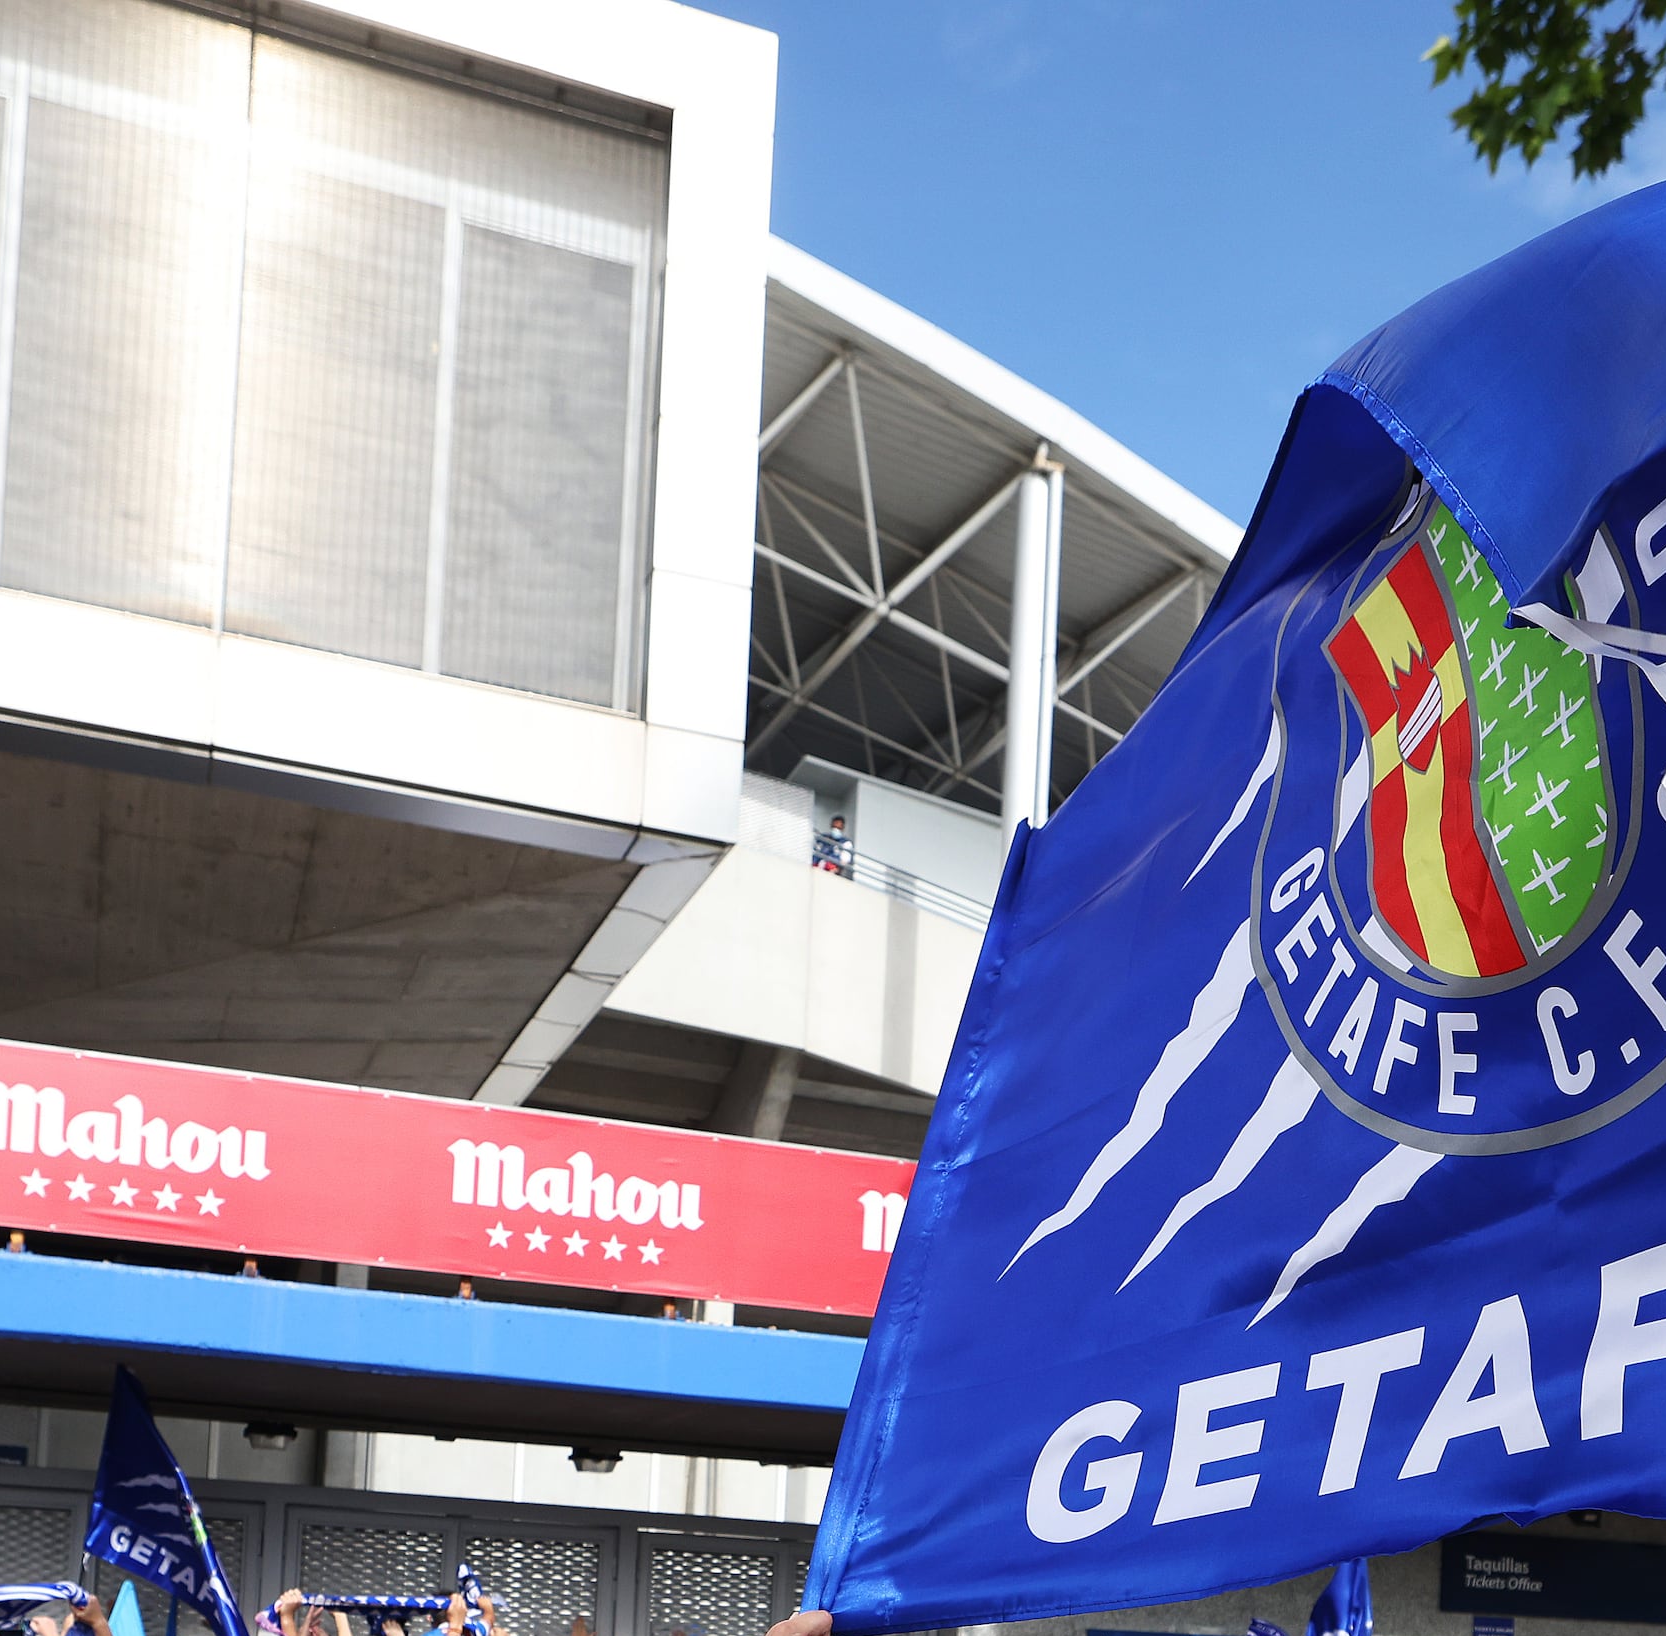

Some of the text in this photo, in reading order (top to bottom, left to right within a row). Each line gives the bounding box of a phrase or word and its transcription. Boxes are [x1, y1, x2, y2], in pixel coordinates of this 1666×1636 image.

[1270, 847, 1479, 1116] GETAFE
[447, 1137, 705, 1231] Mahou
[1464, 1554, 1530, 1575] Taquillas
[1464, 1575, 1543, 1593] Tickets Office
